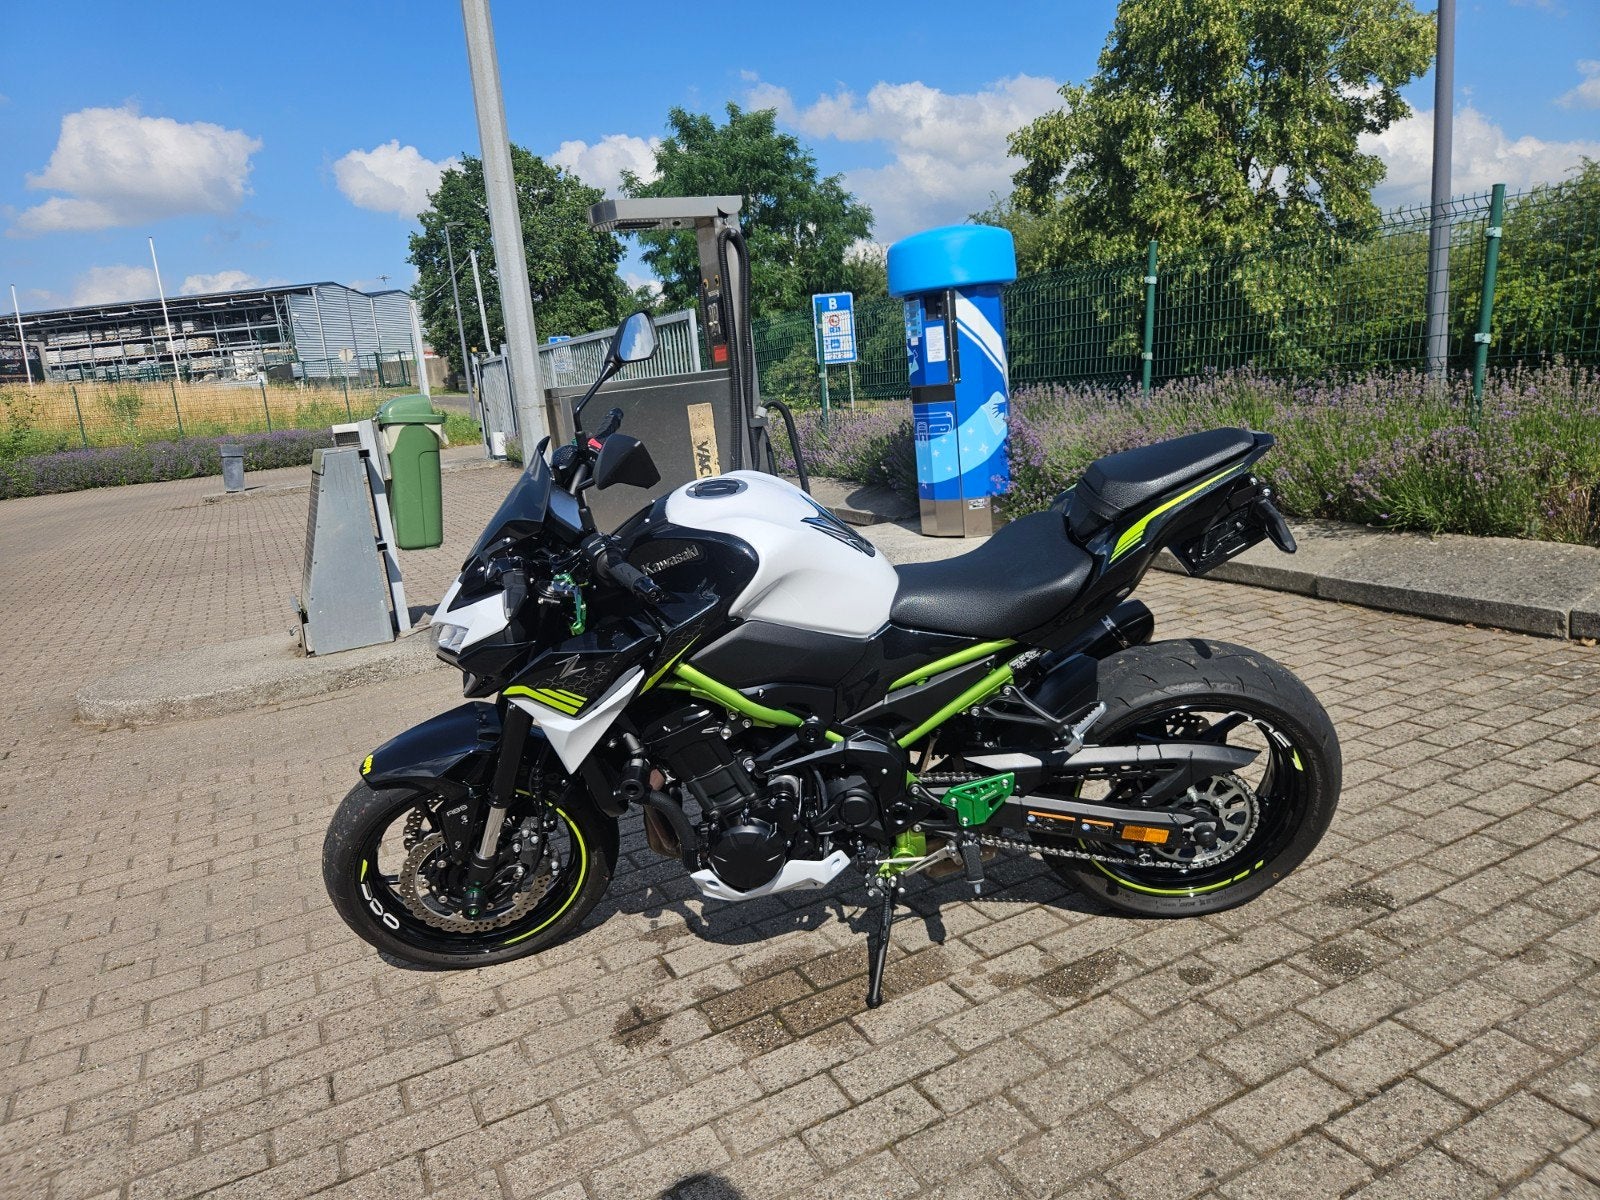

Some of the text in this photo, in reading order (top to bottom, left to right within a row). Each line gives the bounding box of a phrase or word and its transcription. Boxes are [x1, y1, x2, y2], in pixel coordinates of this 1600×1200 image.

[828, 297, 838, 310] B
[696, 440, 713, 478] VAC
[640, 544, 700, 576] Kawasaki
